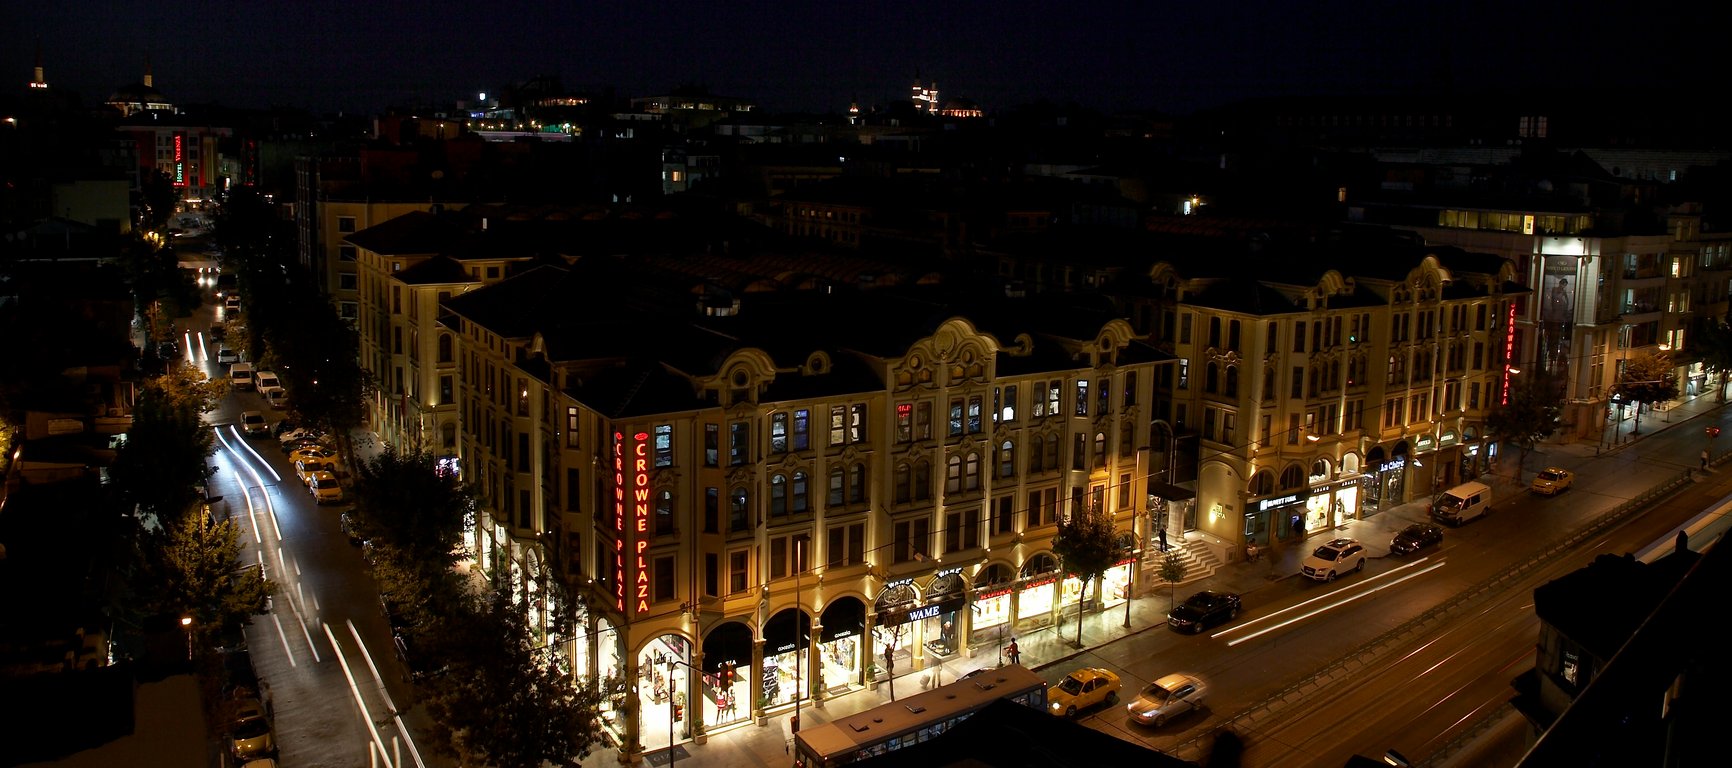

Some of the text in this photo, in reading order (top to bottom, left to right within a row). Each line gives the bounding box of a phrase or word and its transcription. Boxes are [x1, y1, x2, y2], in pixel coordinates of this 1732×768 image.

[1507, 309, 1515, 359] CROWNE
[635, 443, 648, 612] CROWNE PLAZA
[909, 605, 940, 621] WAME
